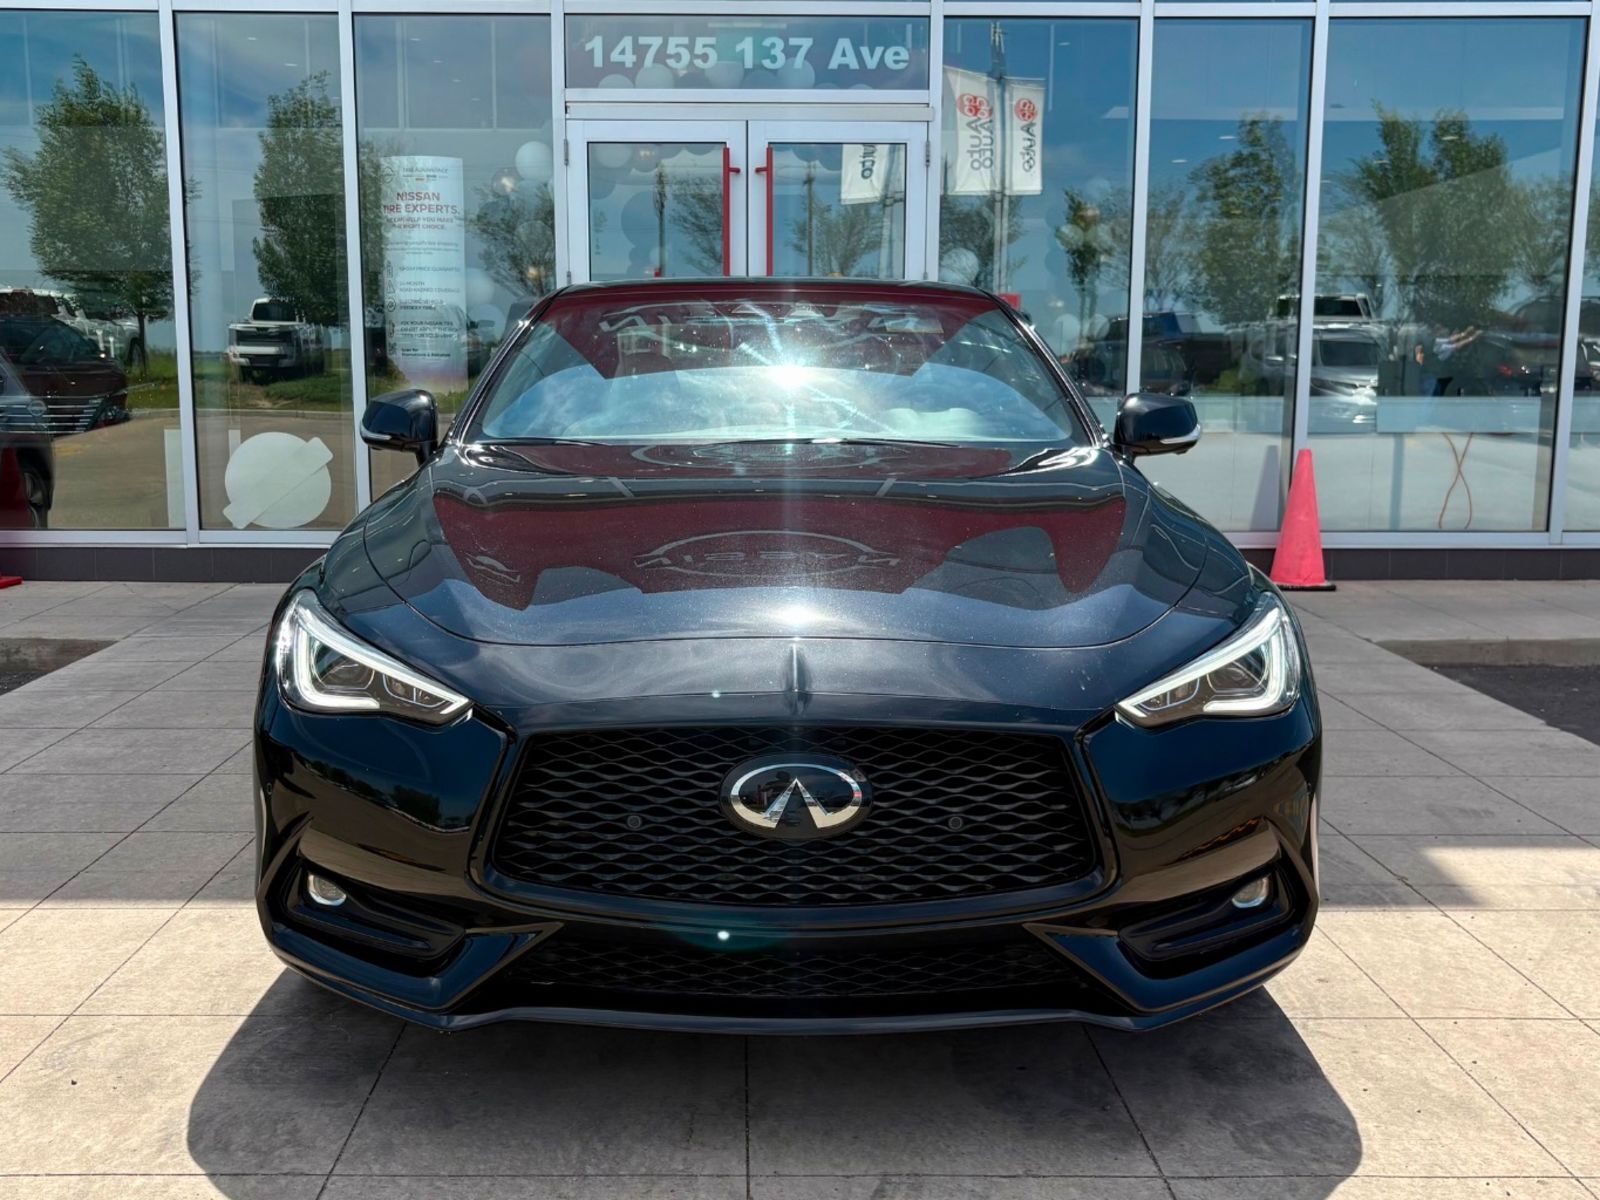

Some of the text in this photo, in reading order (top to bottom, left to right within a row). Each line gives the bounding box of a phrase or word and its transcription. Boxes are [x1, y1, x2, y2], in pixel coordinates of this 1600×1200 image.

[584, 36, 910, 70] 14755 137 Ave
[396, 191, 440, 201] NISSAN
[384, 204, 460, 215] TIRE EXPERTS.
